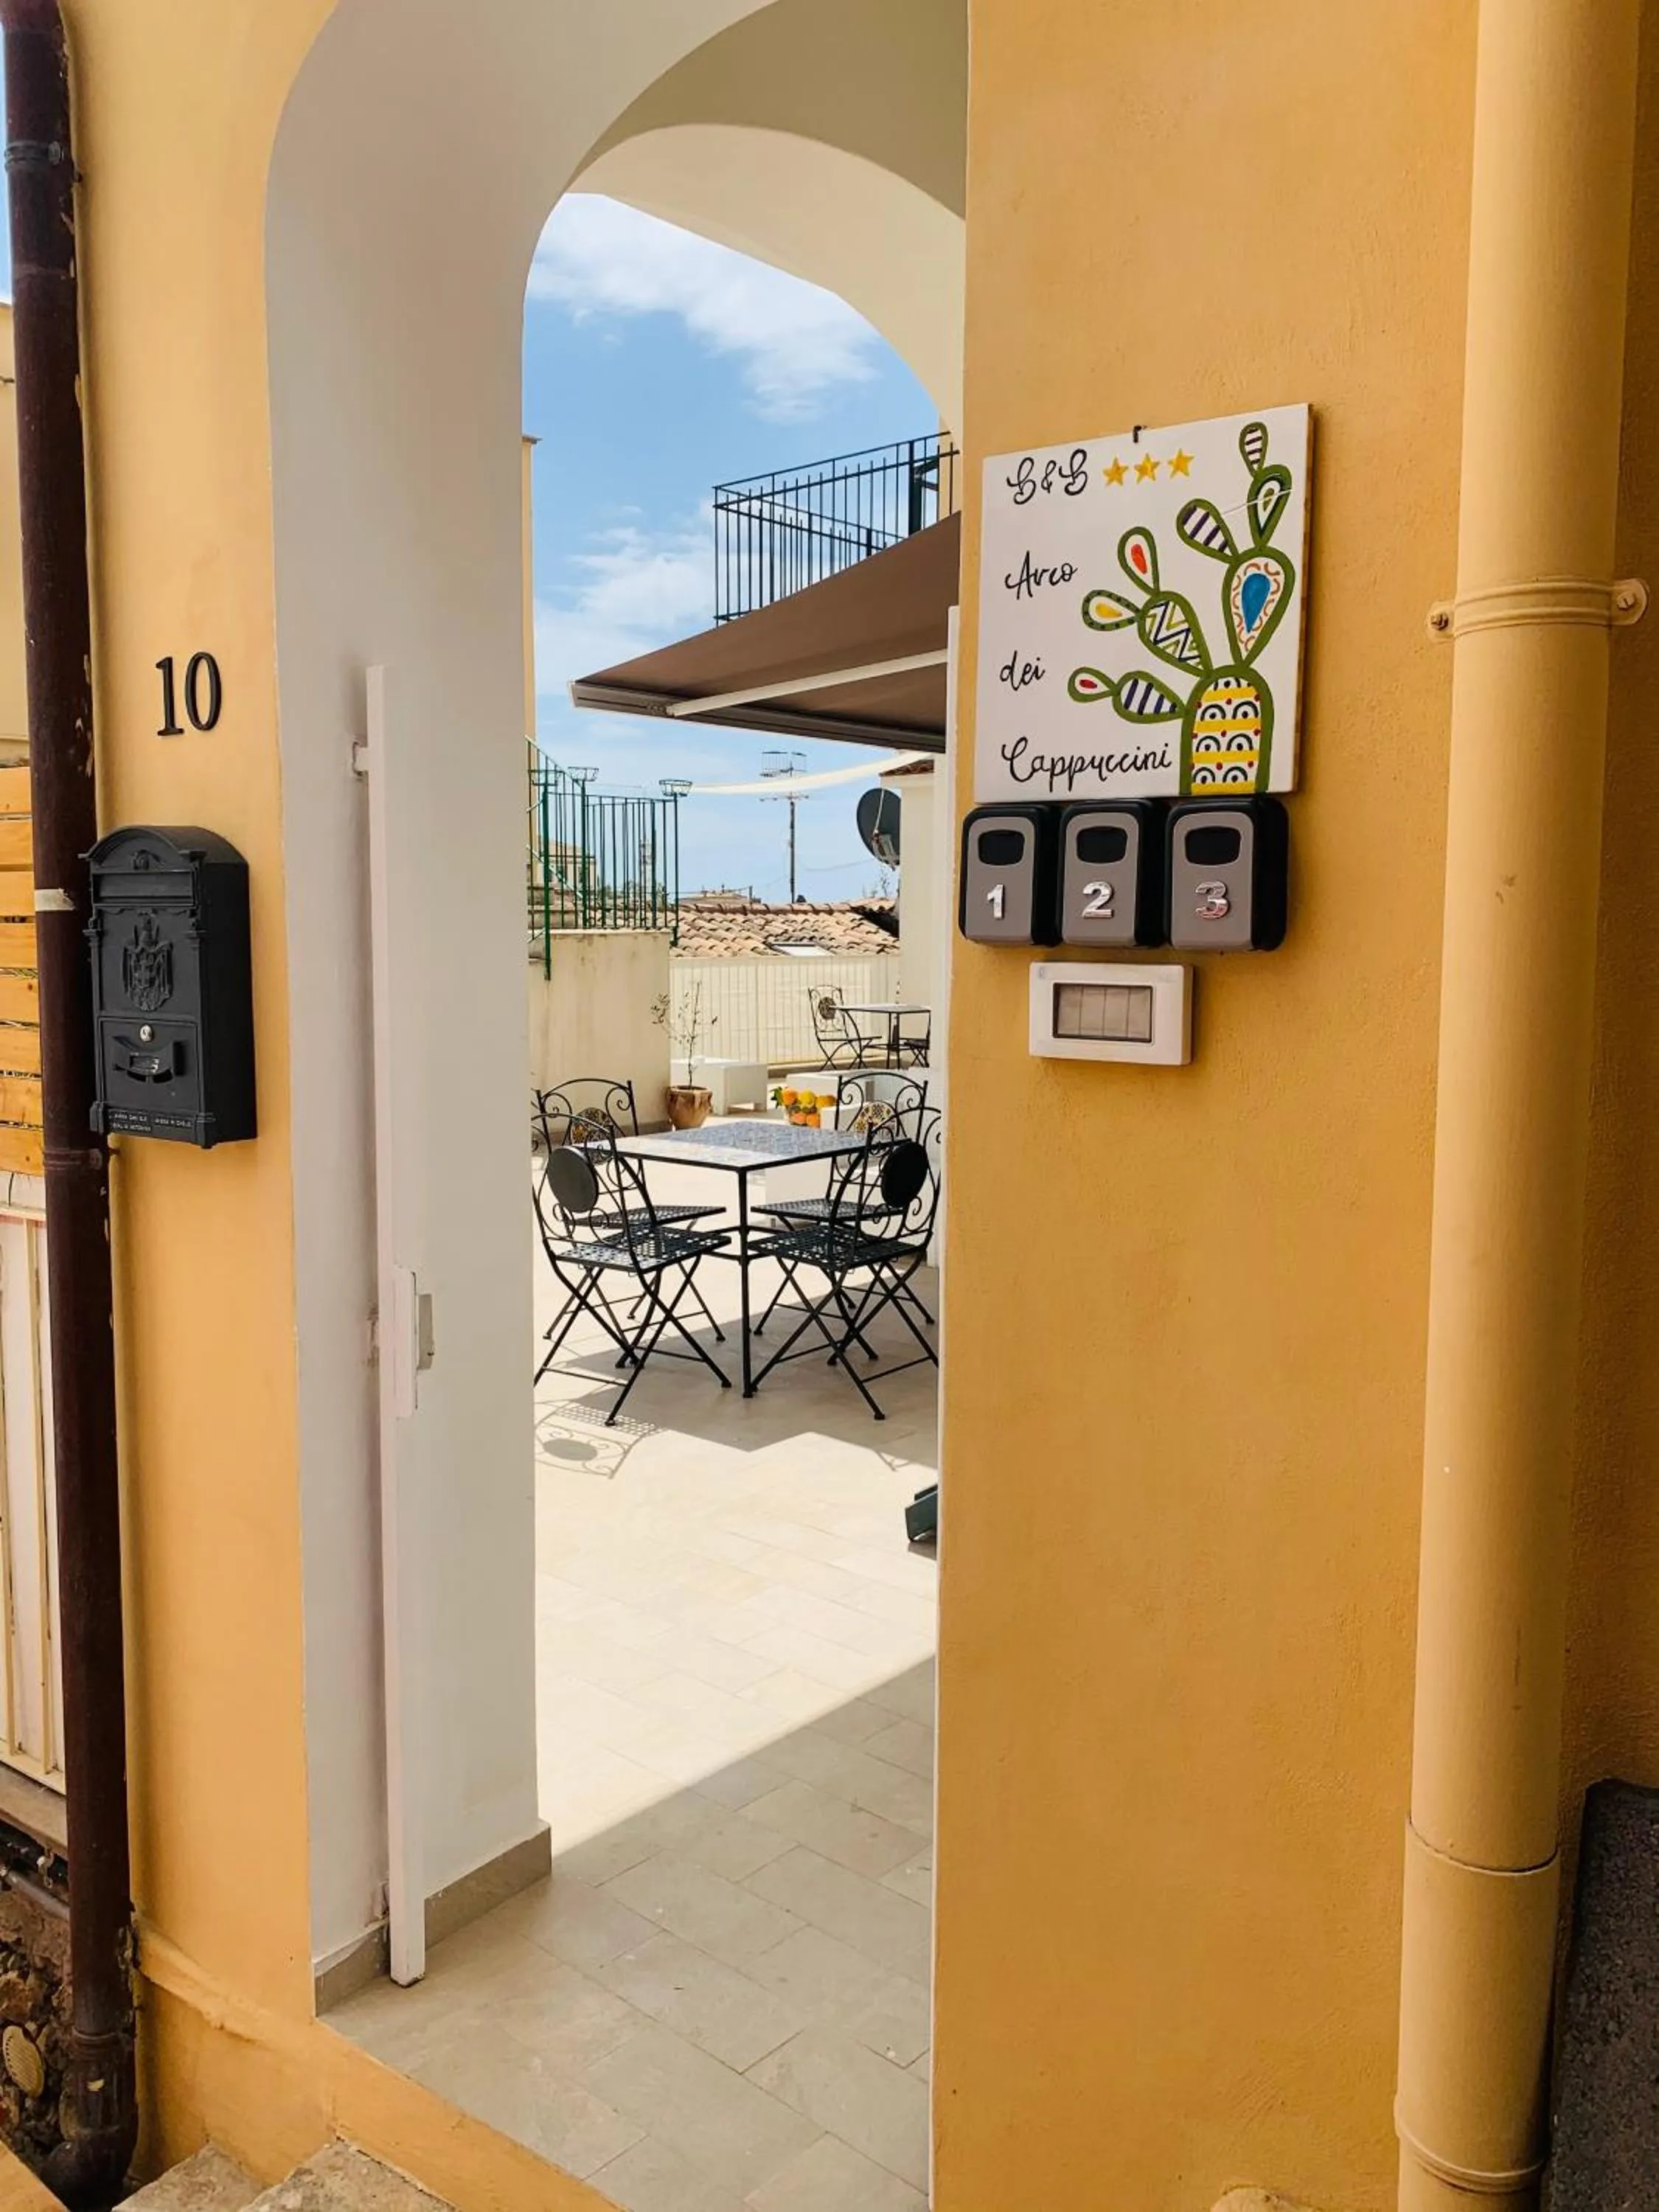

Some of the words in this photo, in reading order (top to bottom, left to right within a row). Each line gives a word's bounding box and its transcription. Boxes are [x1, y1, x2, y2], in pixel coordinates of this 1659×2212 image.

[1006, 449, 1088, 505] B&B
[1005, 551, 1078, 599] Arco
[1000, 650, 1046, 691] dei
[156, 652, 222, 736] 10
[1001, 737, 1172, 793] Cappuccini
[987, 884, 1005, 919] 1
[1082, 881, 1114, 919] 2
[1194, 881, 1231, 919] 3
